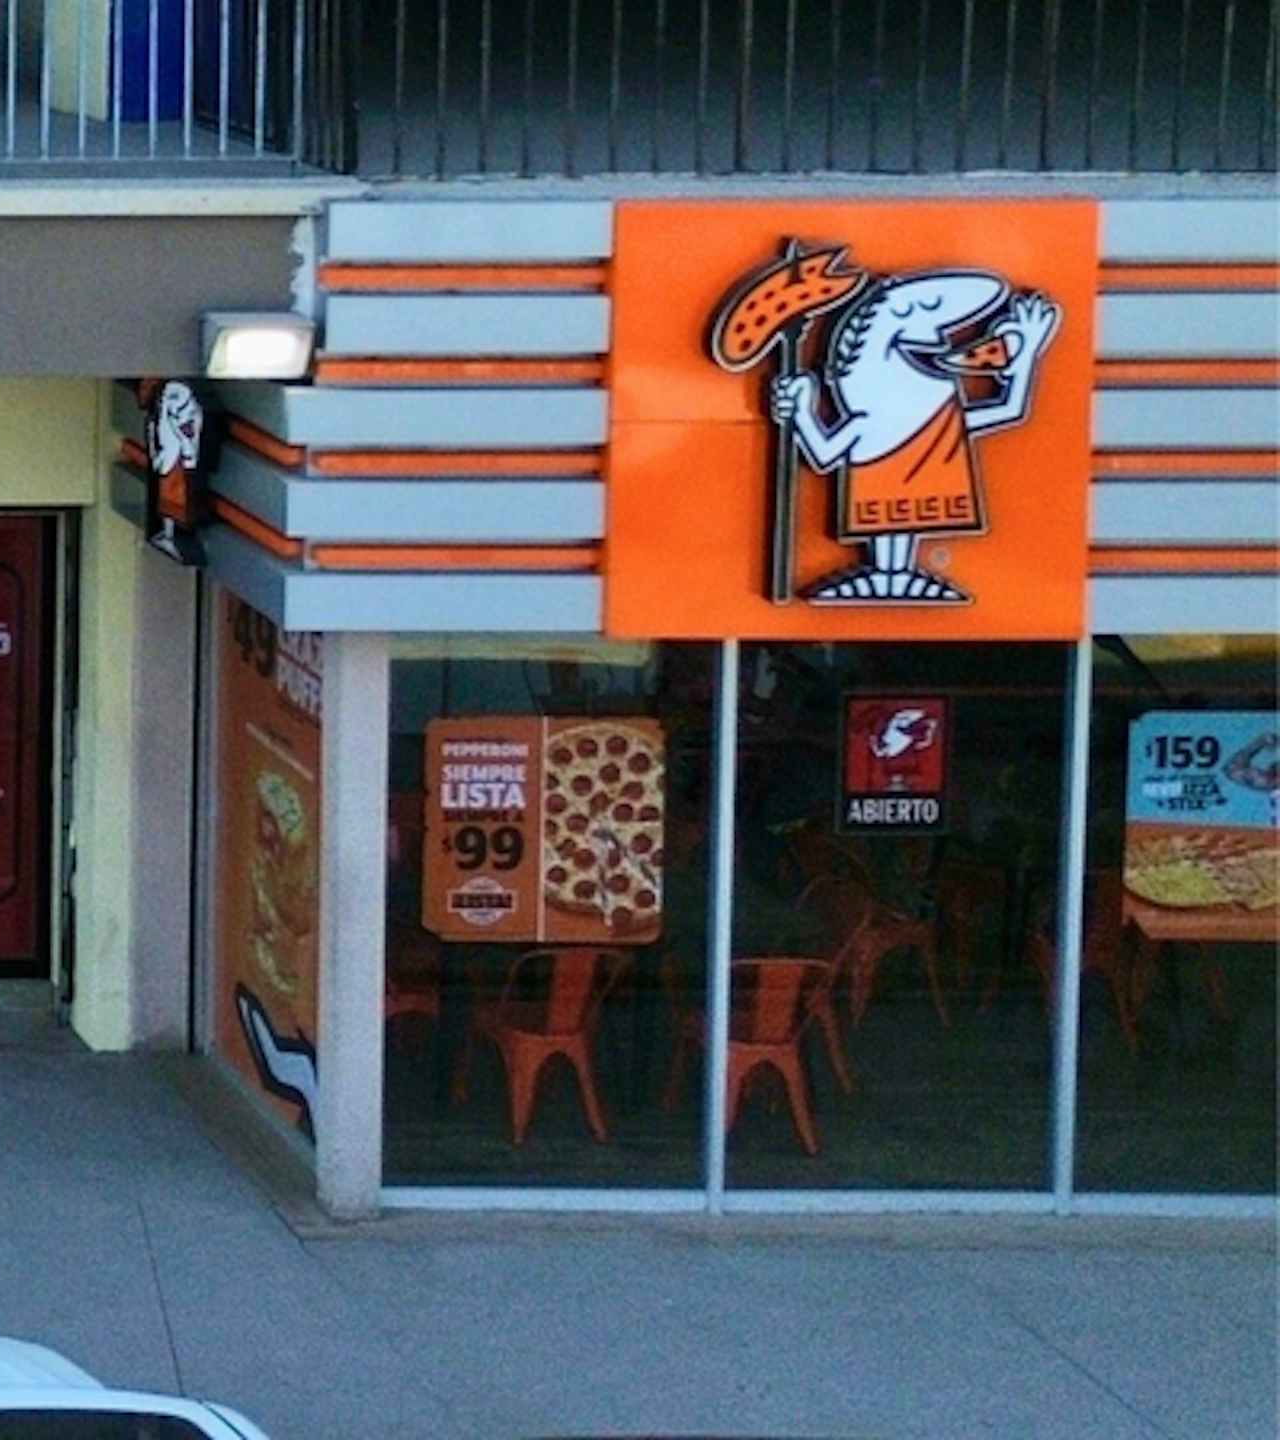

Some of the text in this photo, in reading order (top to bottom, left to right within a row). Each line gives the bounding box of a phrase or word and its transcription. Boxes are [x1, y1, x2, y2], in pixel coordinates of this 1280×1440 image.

[441, 764, 527, 782] SIEMPRE
[441, 783, 527, 809] LISTA
[847, 799, 940, 823] ABIERTO
